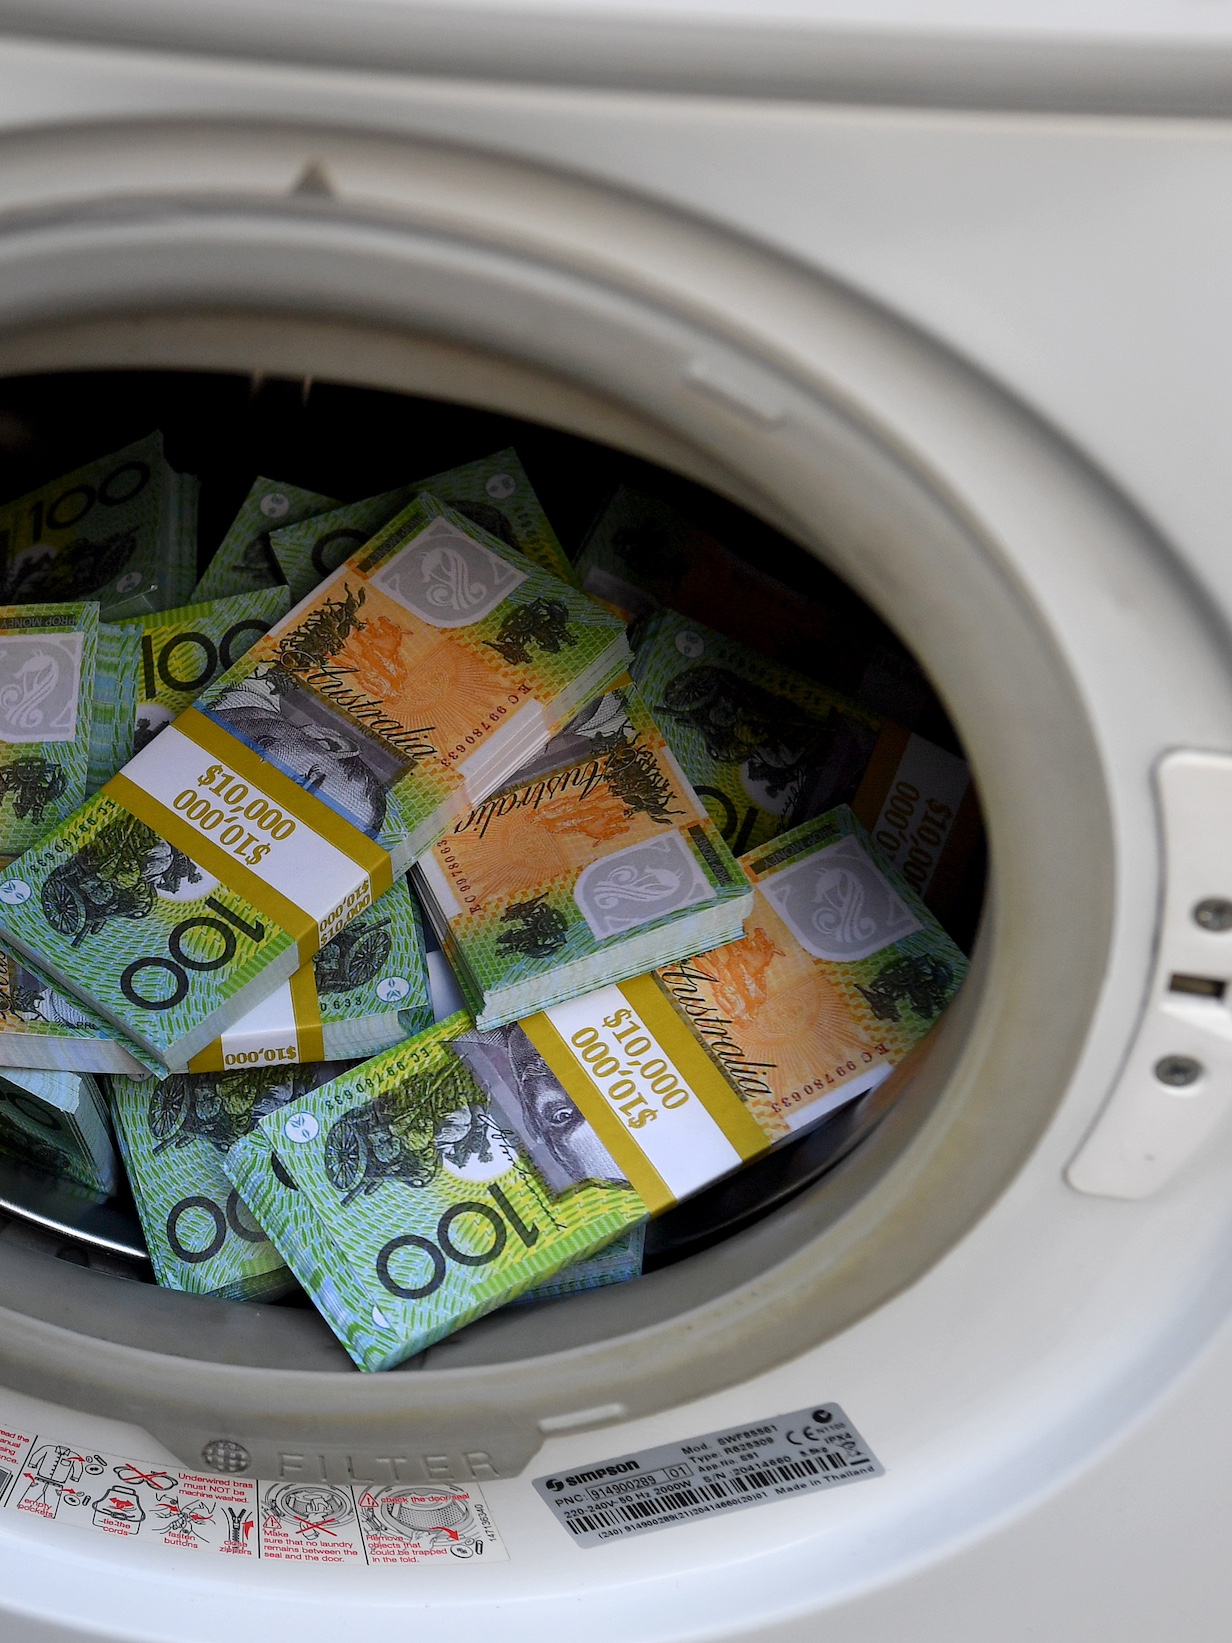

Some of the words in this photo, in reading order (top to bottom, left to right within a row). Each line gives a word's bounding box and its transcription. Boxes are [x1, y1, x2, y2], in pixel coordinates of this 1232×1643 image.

[29, 460, 150, 540] 100
[1, 616, 42, 628] MONEY
[45, 616, 76, 627] PROP
[279, 652, 438, 763] Australia
[197, 765, 296, 840] $10,000
[173, 789, 271, 865] $10,000
[319, 879, 370, 932] $10,000
[121, 896, 265, 1011] 100
[662, 960, 778, 1098] Australia
[225, 1045, 297, 1066] $10,000
[602, 1008, 690, 1109] $10,000
[571, 1027, 658, 1129] $10,000
[376, 1182, 539, 1299] 100
[17, 1434, 30, 1443] the
[681, 1443, 711, 1456] Mod.
[690, 1452, 722, 1465] Type:
[278, 1450, 500, 1483] FILTER
[565, 1459, 641, 1487] SIMPSON
[178, 1472, 230, 1486] Underwired
[233, 1480, 253, 1489] bras
[703, 1472, 726, 1484] S/N
[774, 1483, 807, 1496] Made
[810, 1477, 822, 1487] in
[824, 1465, 876, 1483] Thailand
[183, 1482, 207, 1491] must
[209, 1486, 230, 1494] NOT
[233, 1488, 245, 1496] be
[555, 1493, 587, 1508] PNC:
[590, 1475, 657, 1500] 914900289
[669, 1466, 688, 1479] 01
[636, 1490, 652, 1500] Hz
[653, 1479, 692, 1496] 2000W
[179, 1489, 213, 1499] machine
[215, 1494, 249, 1504] washed.
[381, 1496, 408, 1504] check
[427, 1494, 449, 1502] door
[452, 1492, 470, 1501] seal
[17, 1502, 54, 1518] pockets
[24, 1498, 53, 1511] empty
[102, 1526, 129, 1537] cords
[168, 1531, 196, 1541] fasten
[264, 1530, 289, 1538] Make
[598, 1526, 622, 1540] (240)
[164, 1537, 199, 1549] buttons
[264, 1545, 299, 1553] remains
[302, 1546, 341, 1555] between
[285, 1538, 303, 1546] that
[320, 1540, 353, 1549] laundry
[368, 1541, 402, 1550] objects
[403, 1541, 421, 1549] that
[219, 1546, 252, 1556] zippers
[264, 1551, 282, 1559] seal
[322, 1555, 345, 1563] door.
[370, 1548, 396, 1556] could
[412, 1548, 448, 1557] trapped
[400, 1555, 419, 1563] fold.
